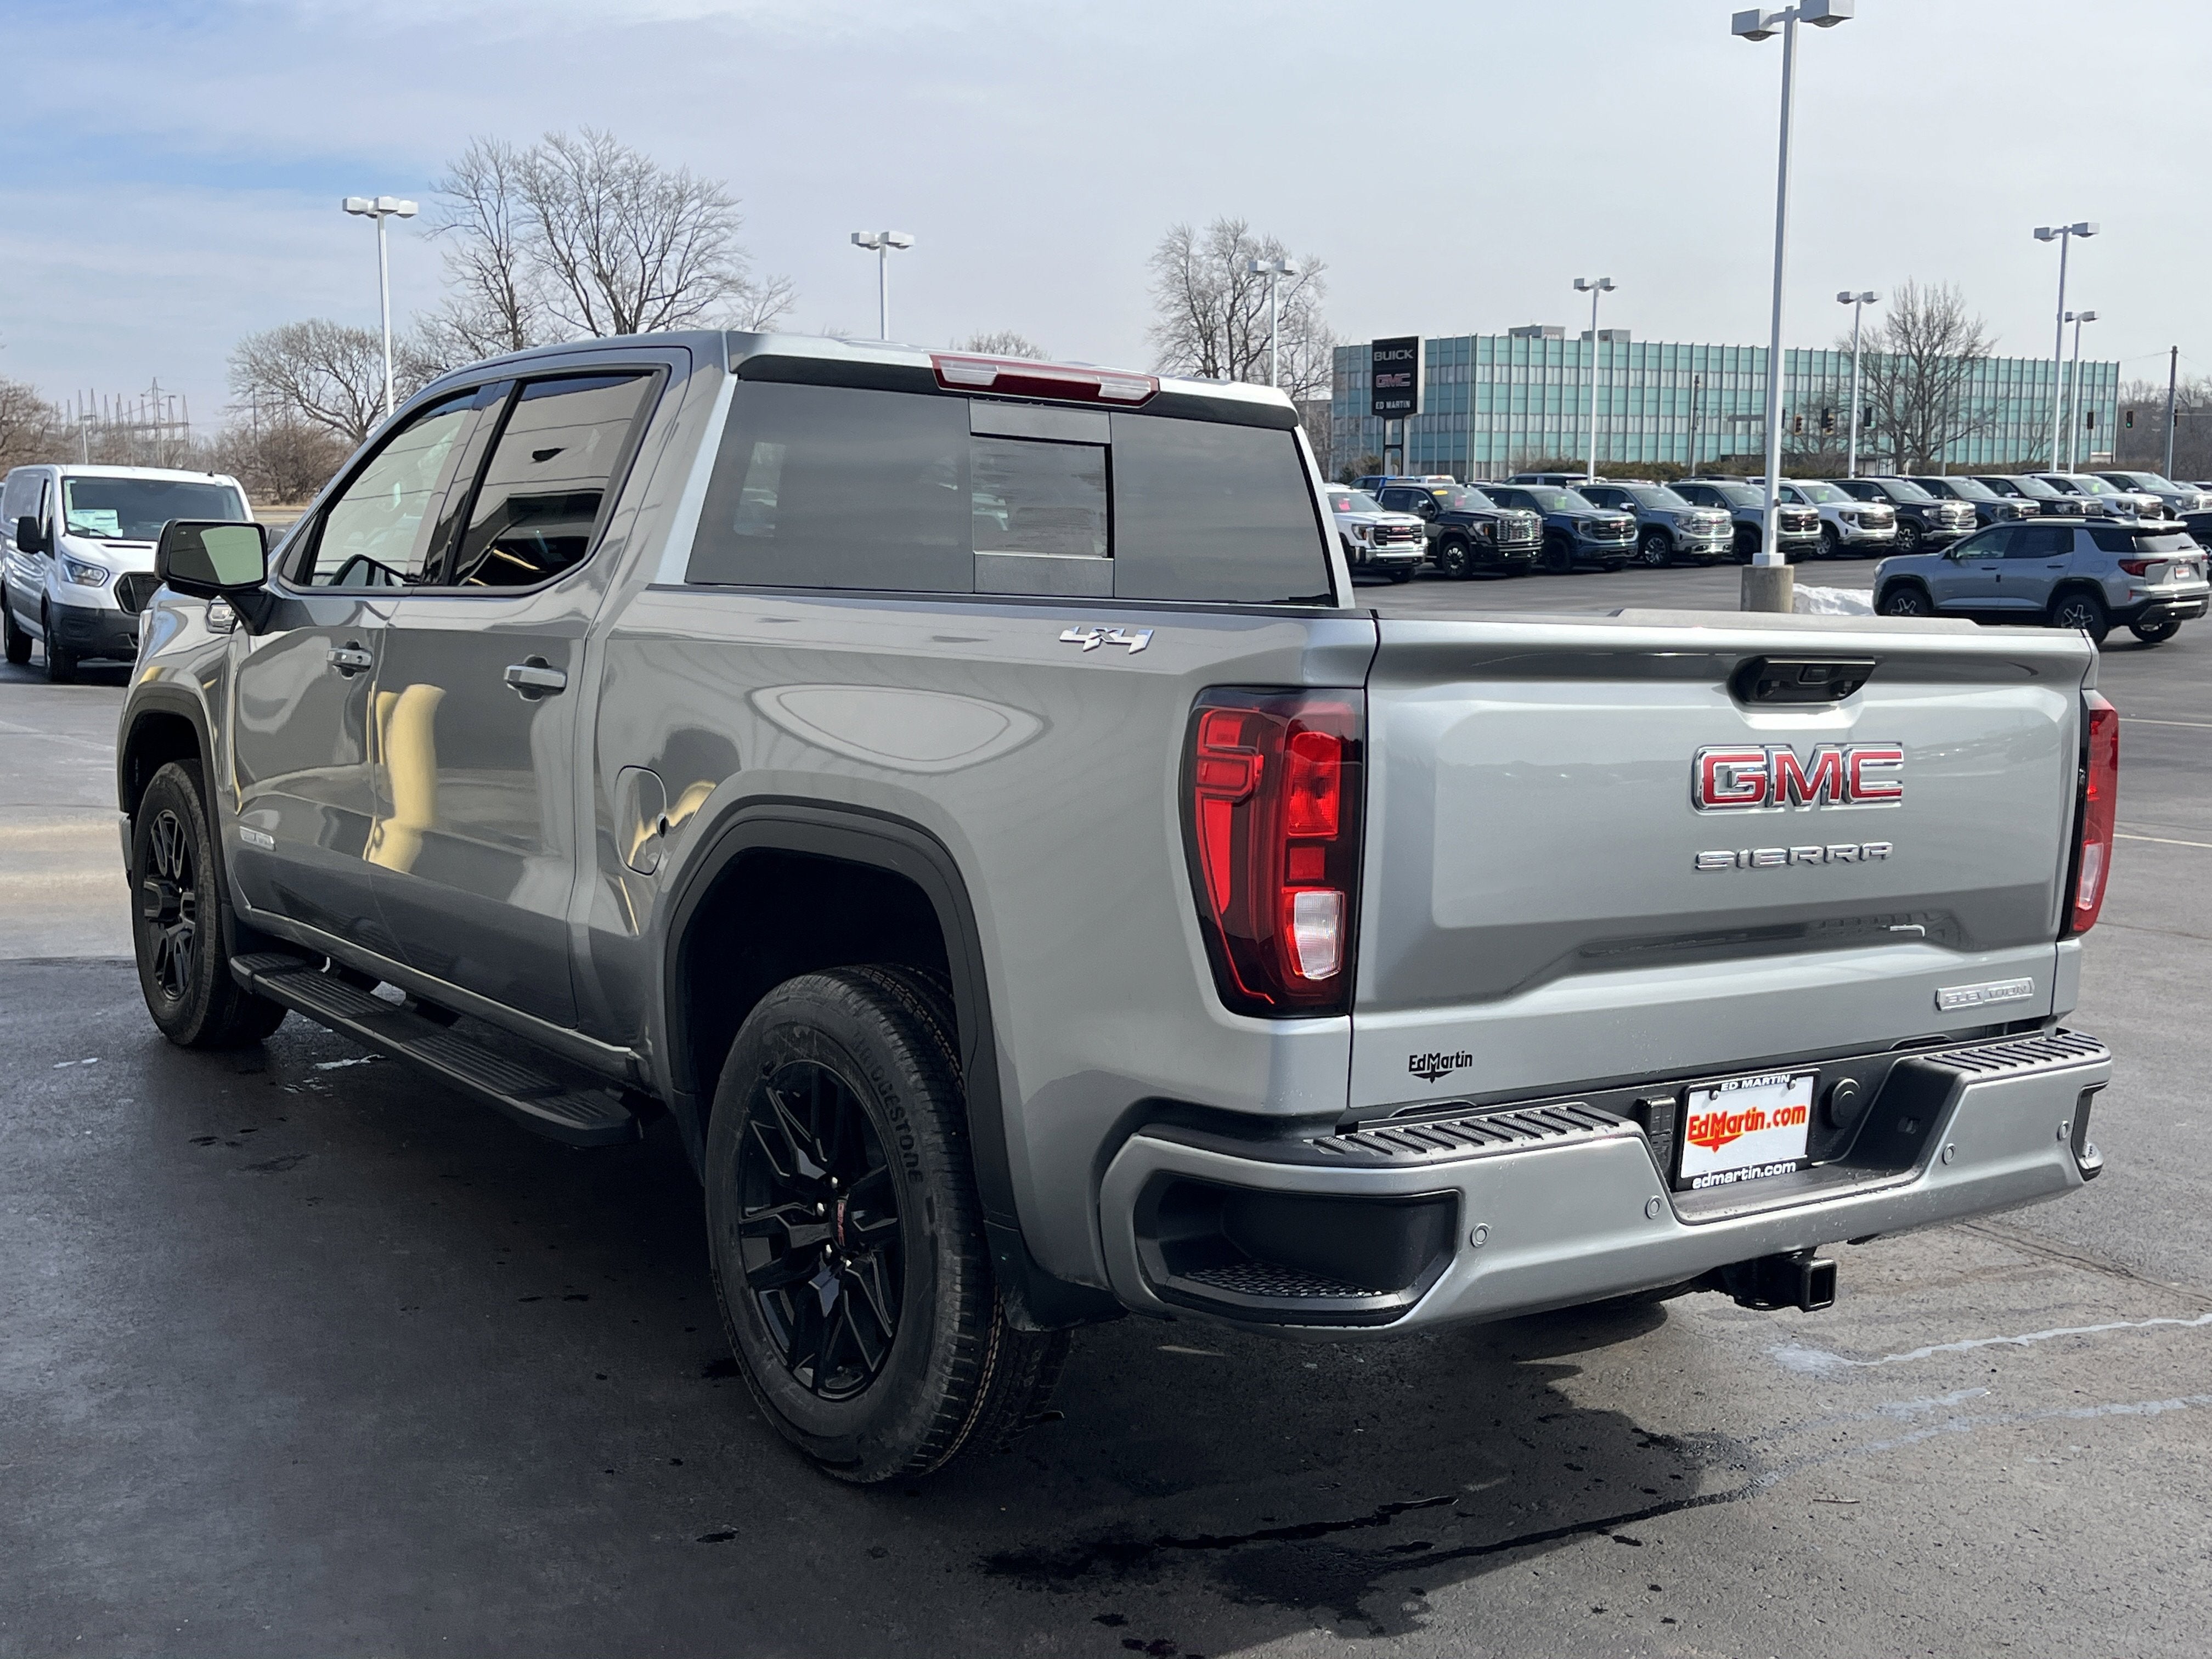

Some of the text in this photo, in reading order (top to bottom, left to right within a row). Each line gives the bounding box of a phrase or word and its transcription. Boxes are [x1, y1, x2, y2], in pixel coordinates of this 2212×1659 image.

[1373, 349, 1414, 362] BUICK
[1376, 373, 1410, 388] GMC
[1375, 400, 1410, 410] ED MARTIN
[1691, 741, 1904, 816] GMC
[1695, 842, 1893, 871] SIERRA
[1720, 1074, 1791, 1092] ED MARTIN
[1692, 1160, 1796, 1189] edmartin.com
